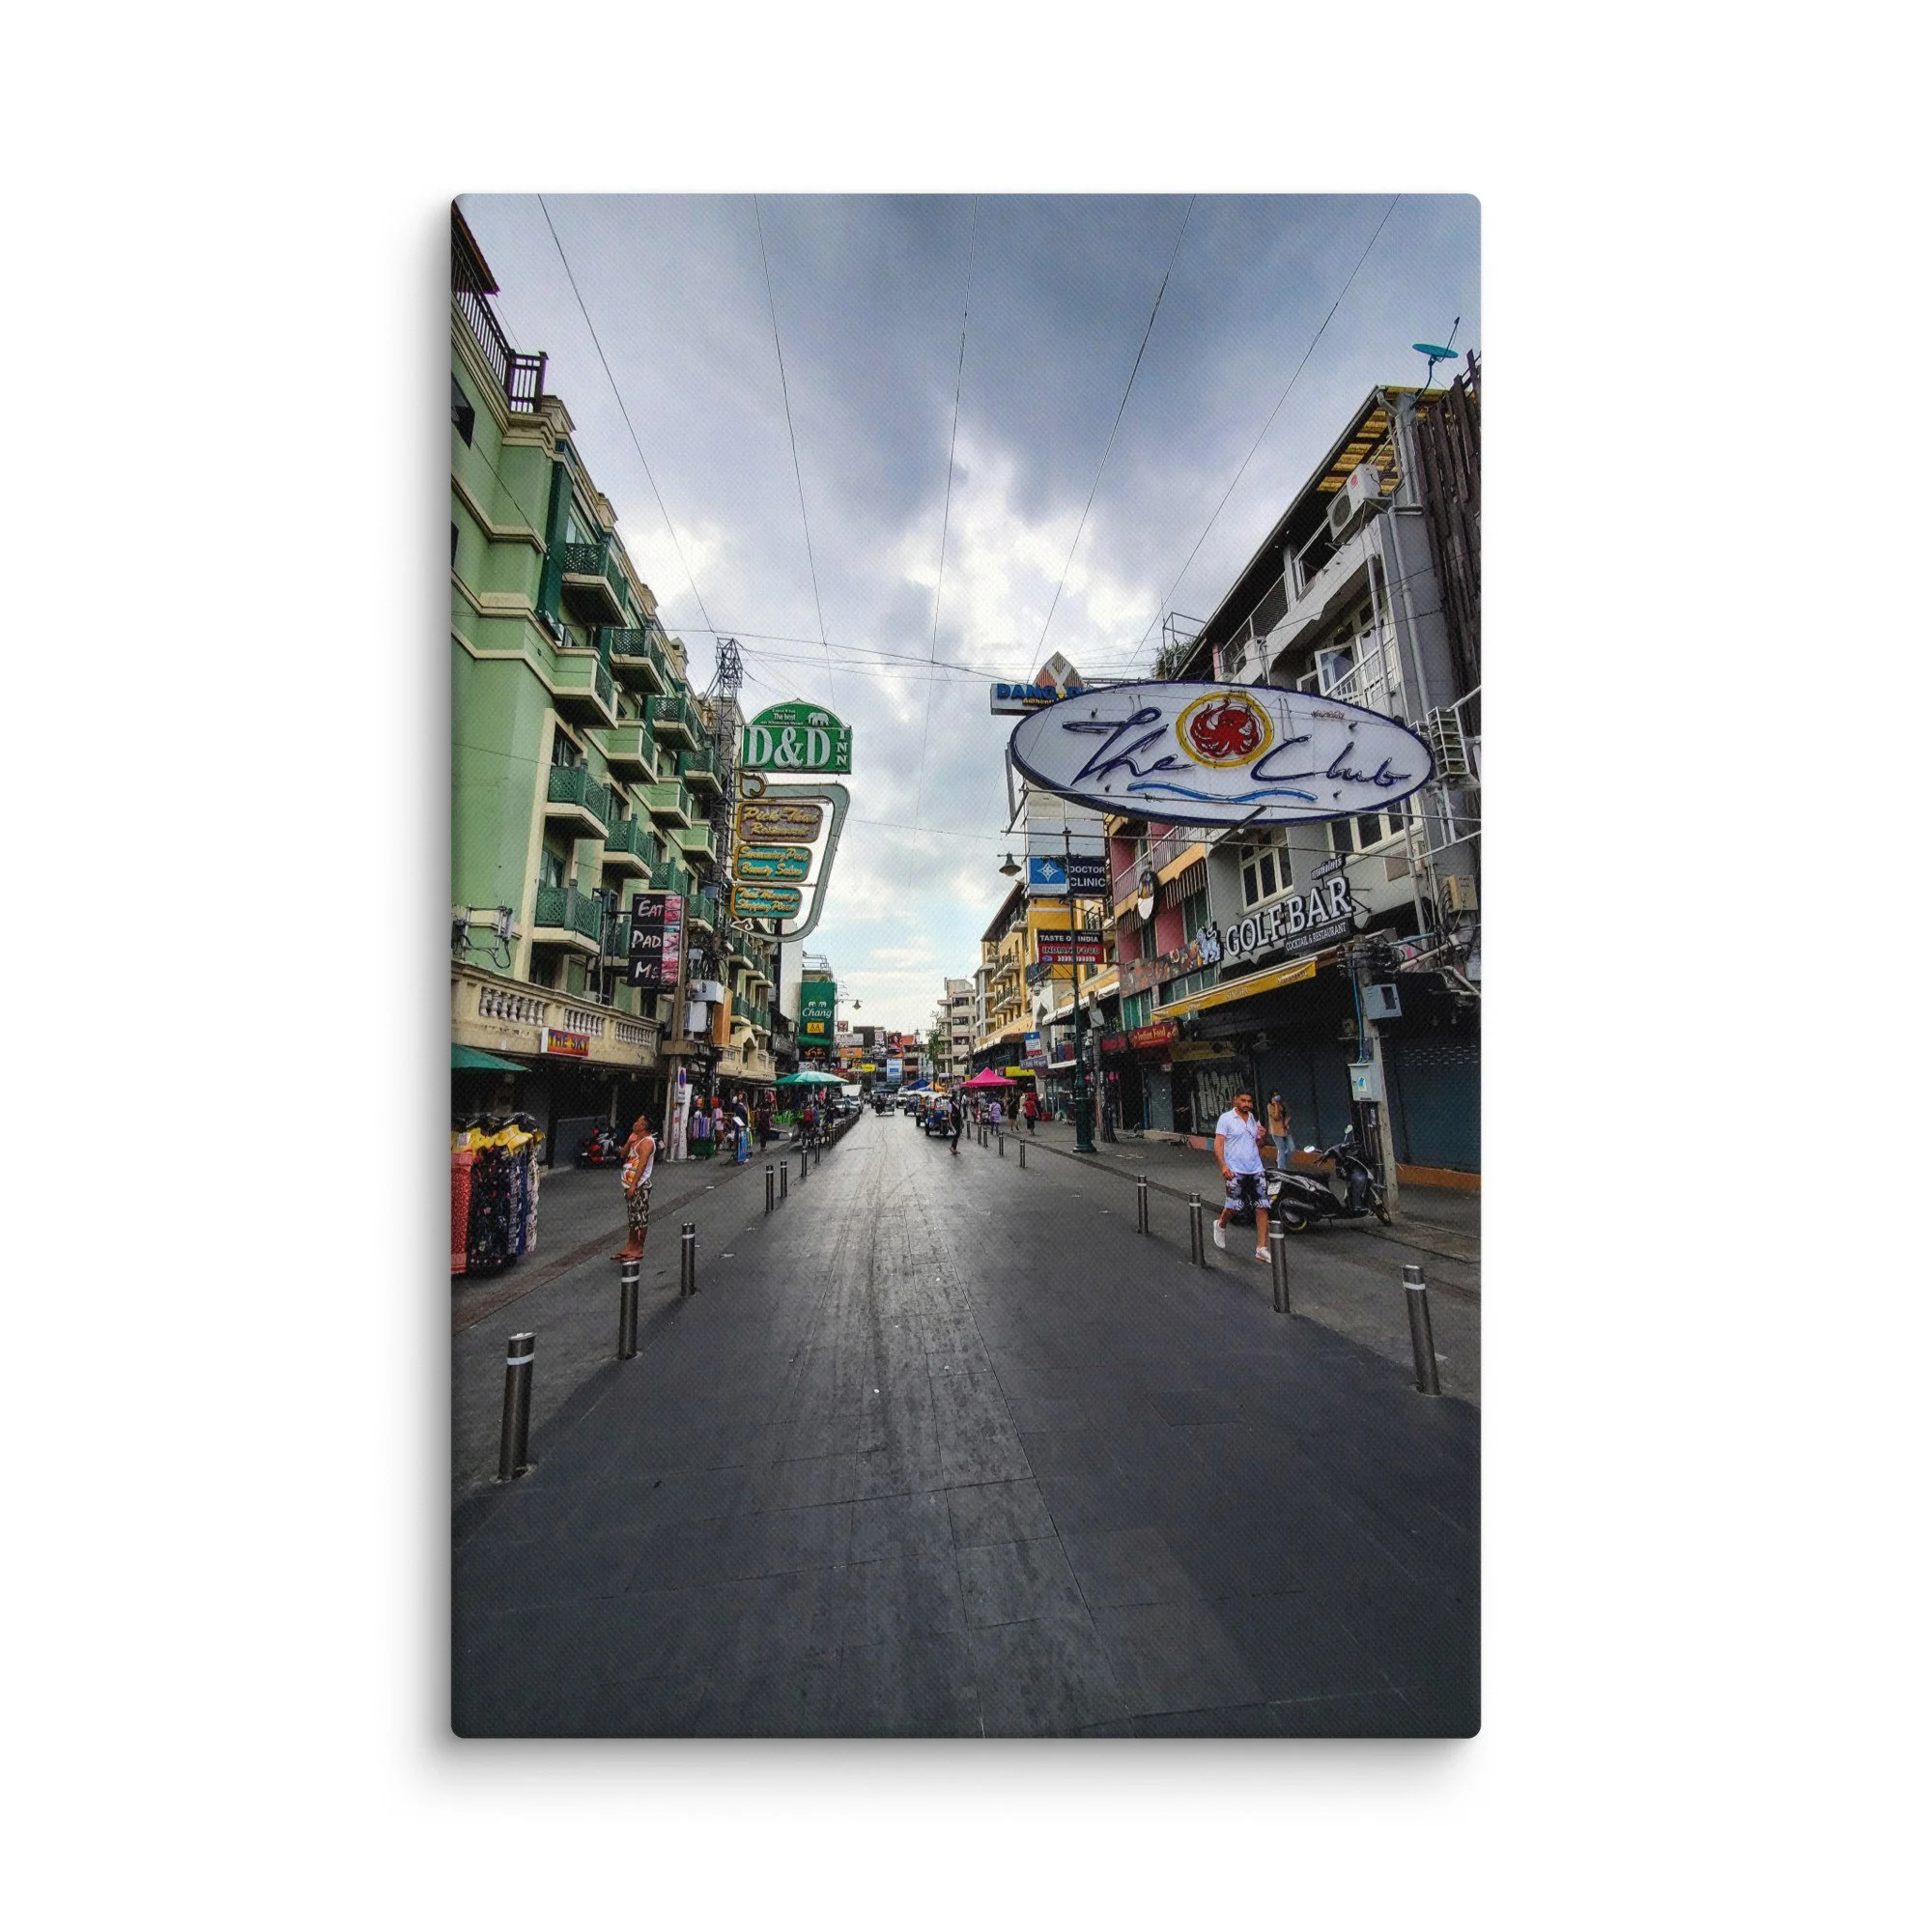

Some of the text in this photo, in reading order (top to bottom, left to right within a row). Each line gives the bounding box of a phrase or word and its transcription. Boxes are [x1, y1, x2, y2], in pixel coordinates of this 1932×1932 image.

[996, 683, 1058, 700] DANG
[744, 726, 831, 769] D&D
[837, 728, 848, 766] INN
[1062, 707, 1411, 787] The Club
[1070, 877, 1106, 887] CLINIC
[638, 899, 664, 918] EAT
[1225, 875, 1352, 956] GOLF BAR
[631, 929, 662, 949] PAD
[1285, 921, 1348, 952] COCKTAIL & RESTAURANT
[1041, 946, 1100, 955] INDIAN FOOD
[802, 1008, 833, 1019] Chang
[548, 1031, 588, 1051] THE SKY
[1137, 1026, 1166, 1041] Indian Food
